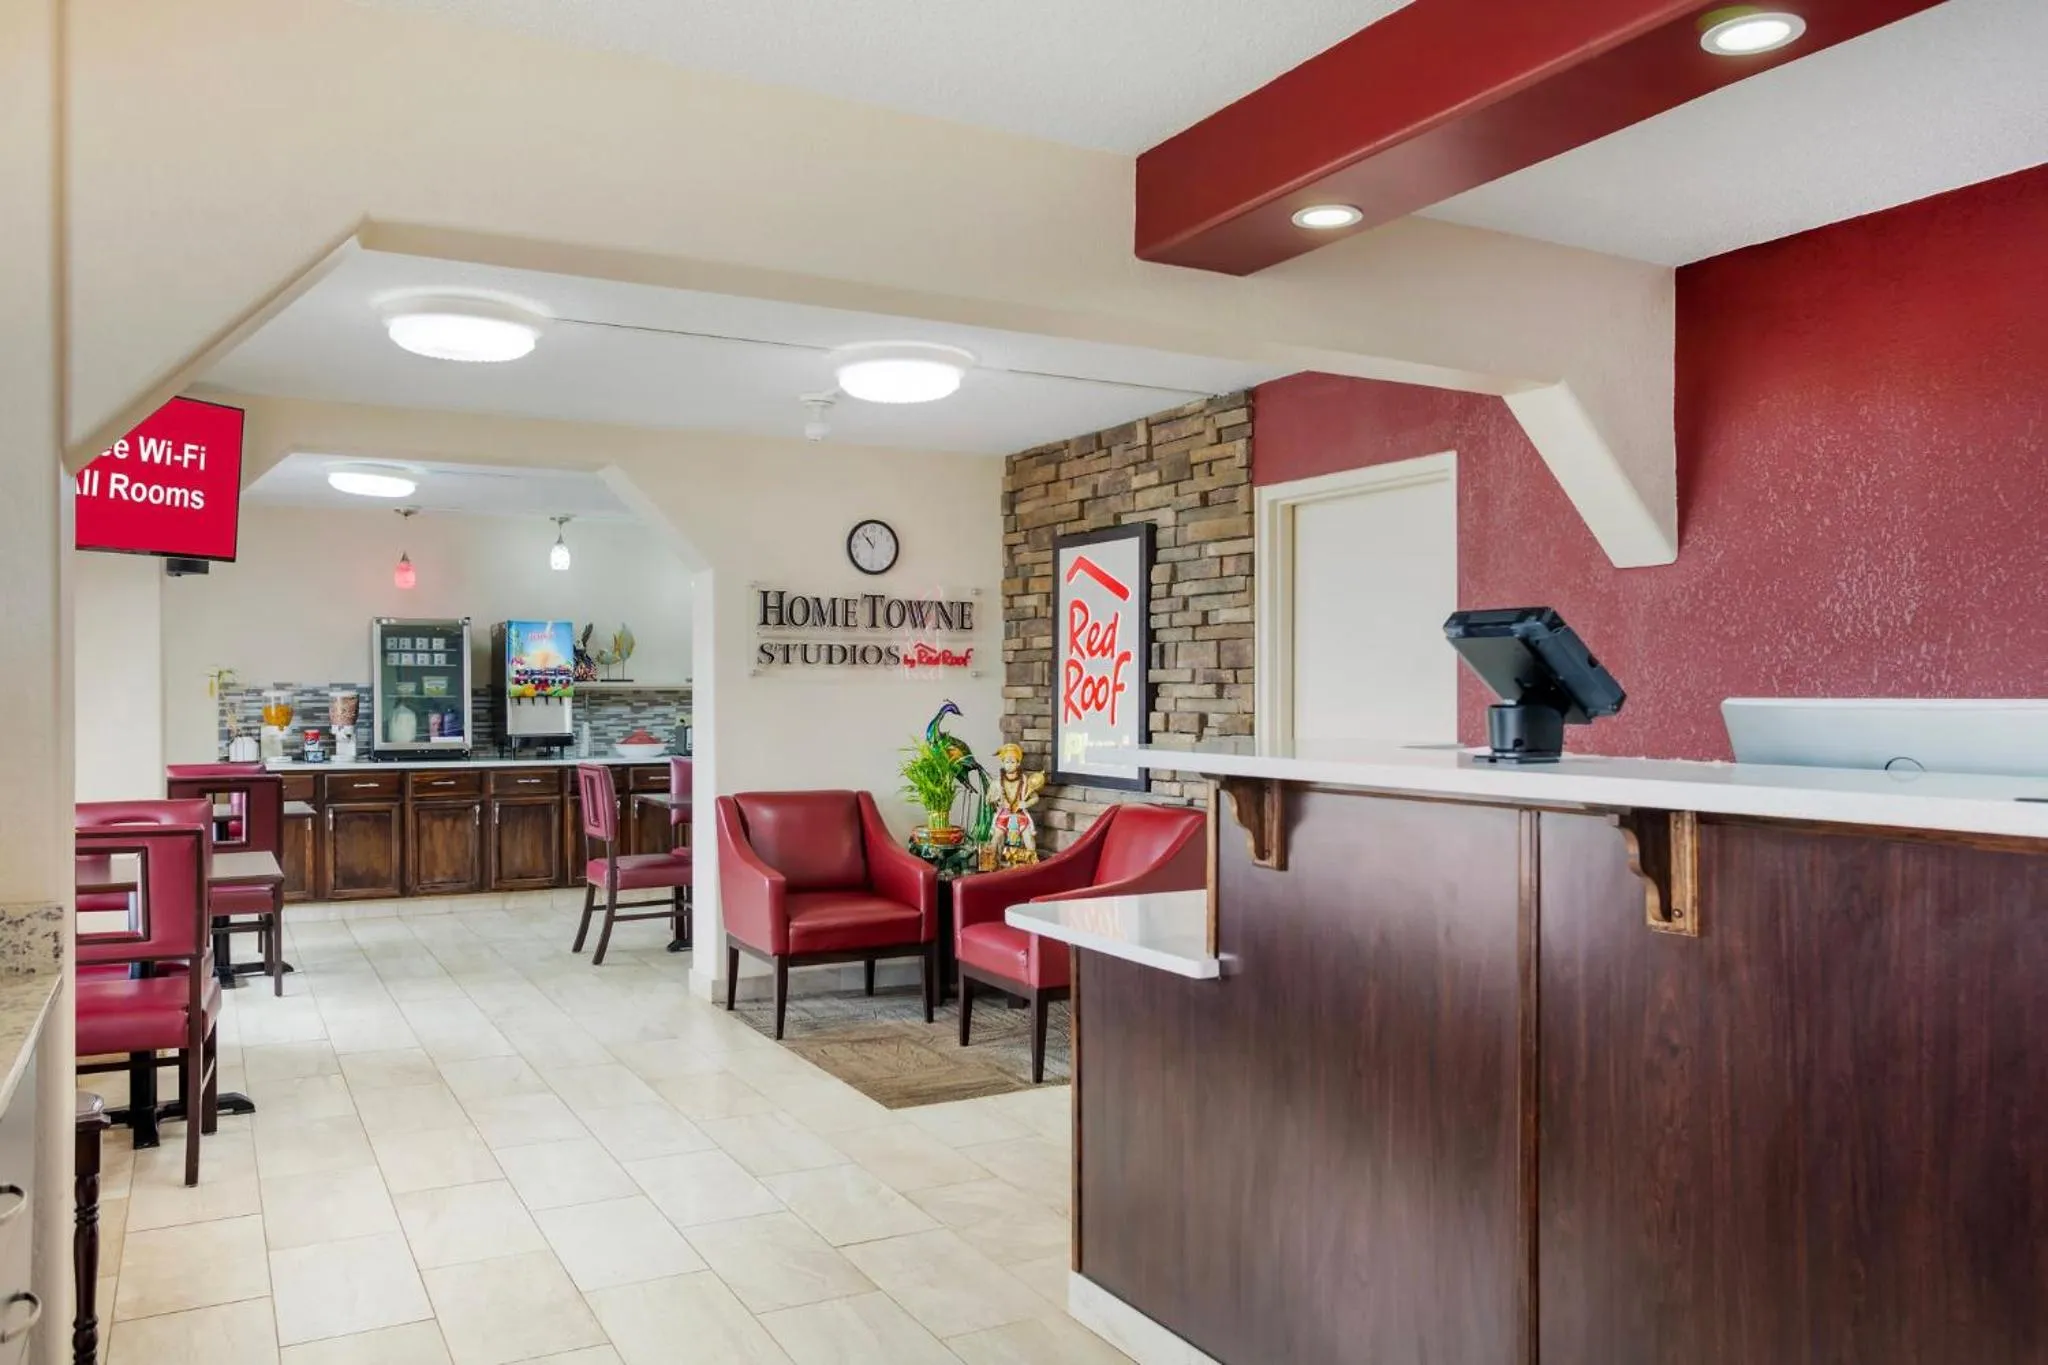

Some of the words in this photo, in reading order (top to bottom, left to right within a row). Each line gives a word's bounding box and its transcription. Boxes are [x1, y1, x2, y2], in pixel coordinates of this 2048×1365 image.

[138, 435, 206, 471] Wi-Fi
[108, 472, 205, 510] Rooms
[1068, 599, 1119, 661] Red
[757, 642, 901, 666] STUDIOS
[1064, 651, 1131, 727] Roof
